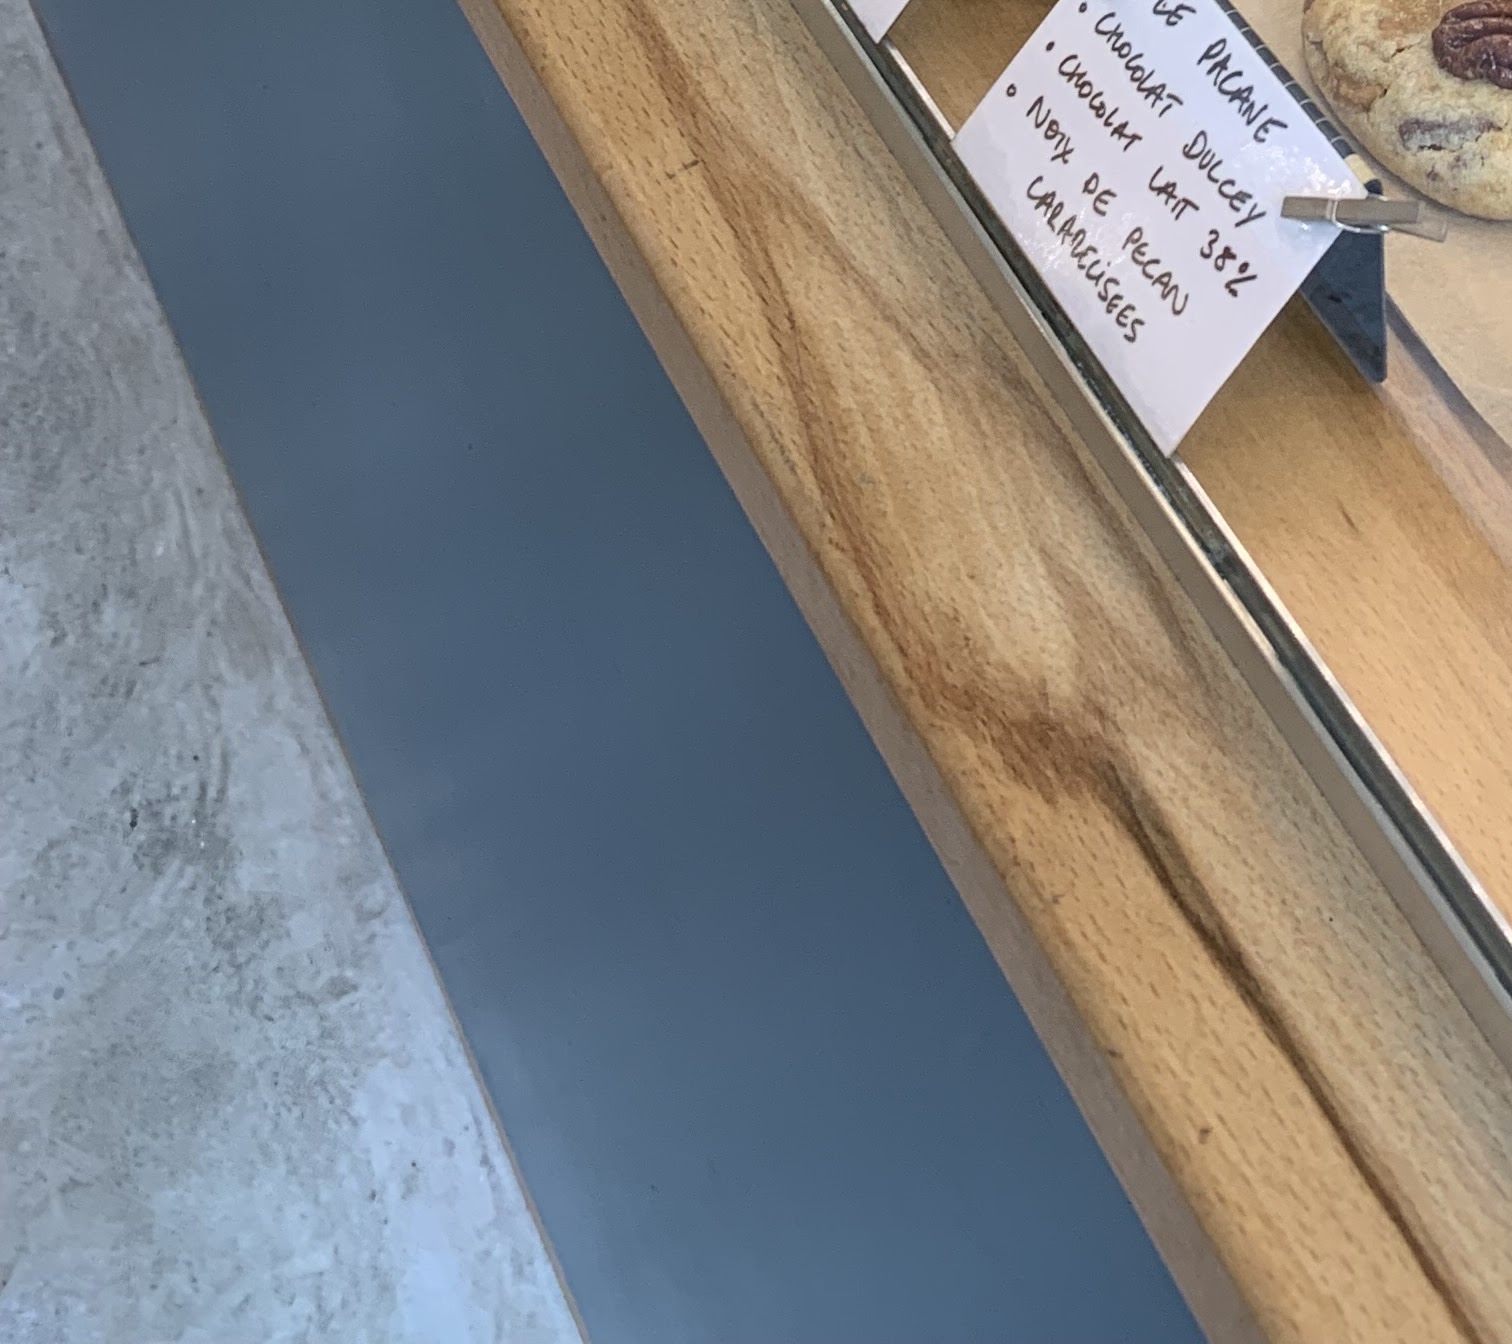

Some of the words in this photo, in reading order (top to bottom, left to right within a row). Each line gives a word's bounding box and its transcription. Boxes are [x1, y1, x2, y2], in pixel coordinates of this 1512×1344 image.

[1058, 54, 1143, 152] CHOCOLAT
[1148, 165, 1200, 222] LAIT
[1199, 229, 1259, 297] 38%
[1094, 12, 1185, 117] CHOCOLAT
[1182, 130, 1268, 228] DULCEY
[1196, 38, 1288, 145] PACANE
[1025, 95, 1075, 164] NOIX
[1082, 172, 1119, 217] DE
[1123, 227, 1189, 316] PECAN
